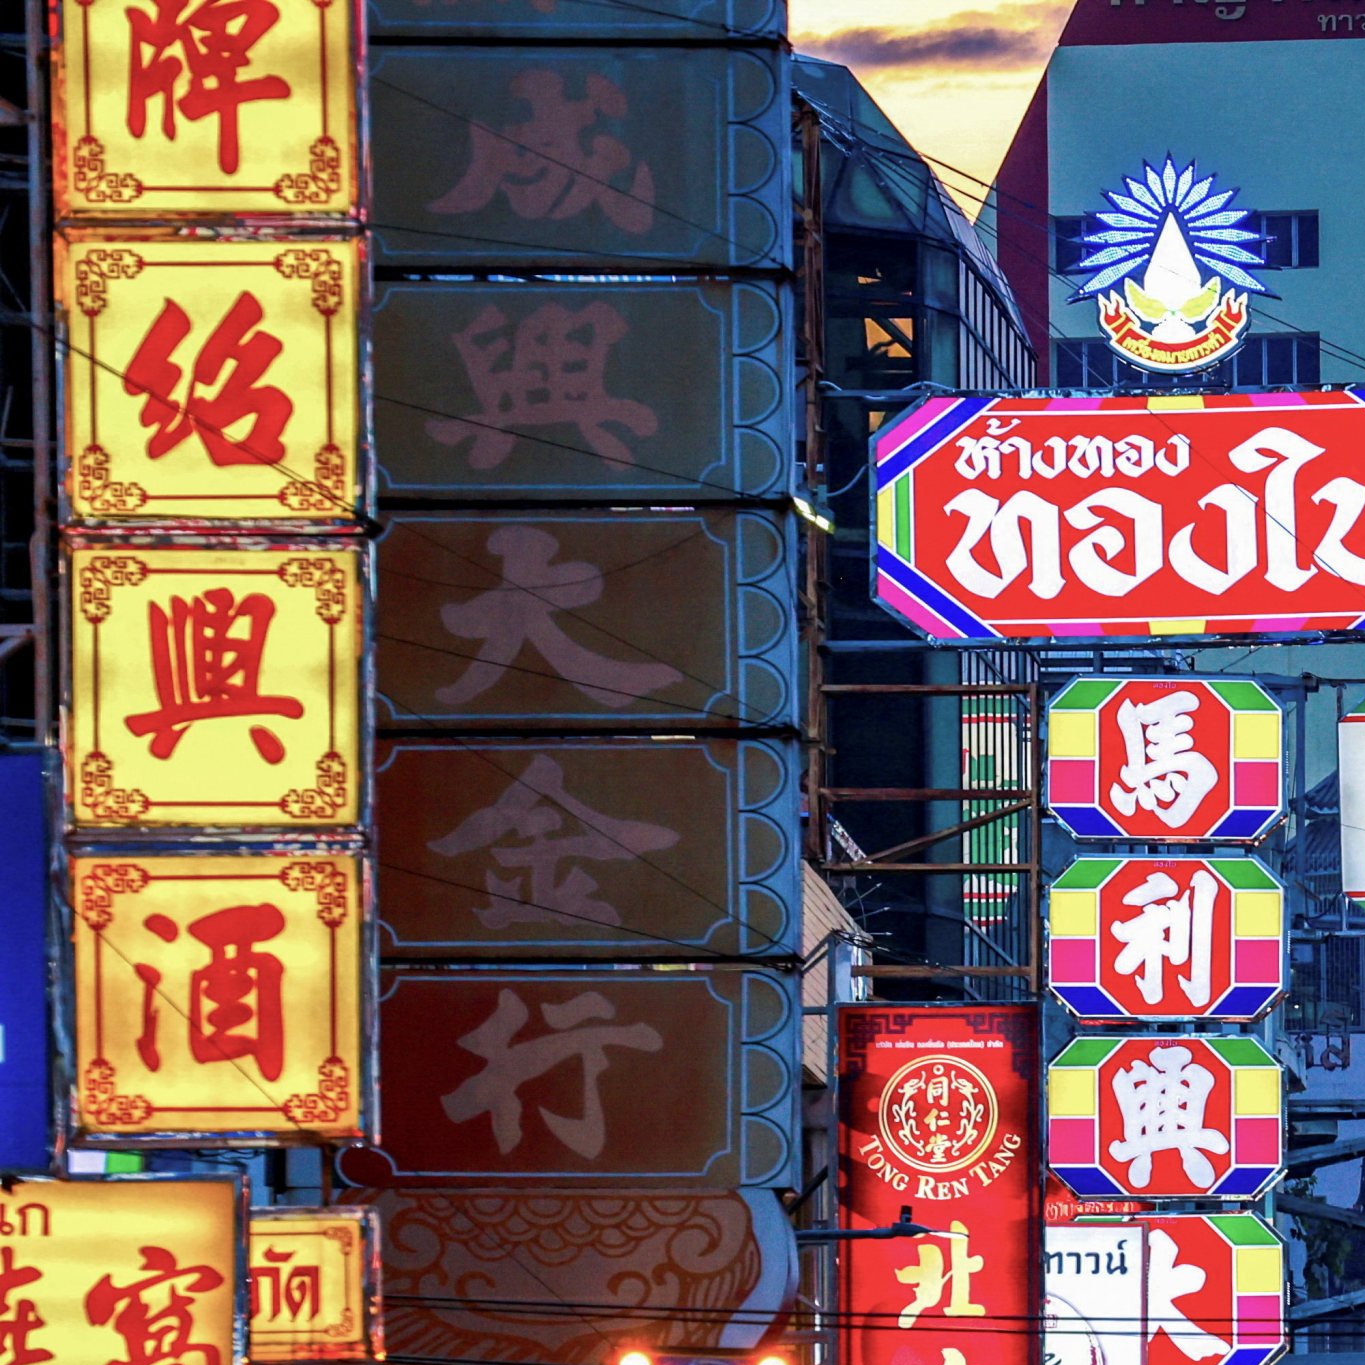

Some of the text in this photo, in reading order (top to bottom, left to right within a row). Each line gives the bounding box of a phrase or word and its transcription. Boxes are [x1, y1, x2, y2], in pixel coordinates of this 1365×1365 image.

[956, 417, 1191, 482] ห้างทอง
[924, 1076, 951, 1163] 同仁堂
[858, 1133, 1022, 1200] TONG REN TANG
